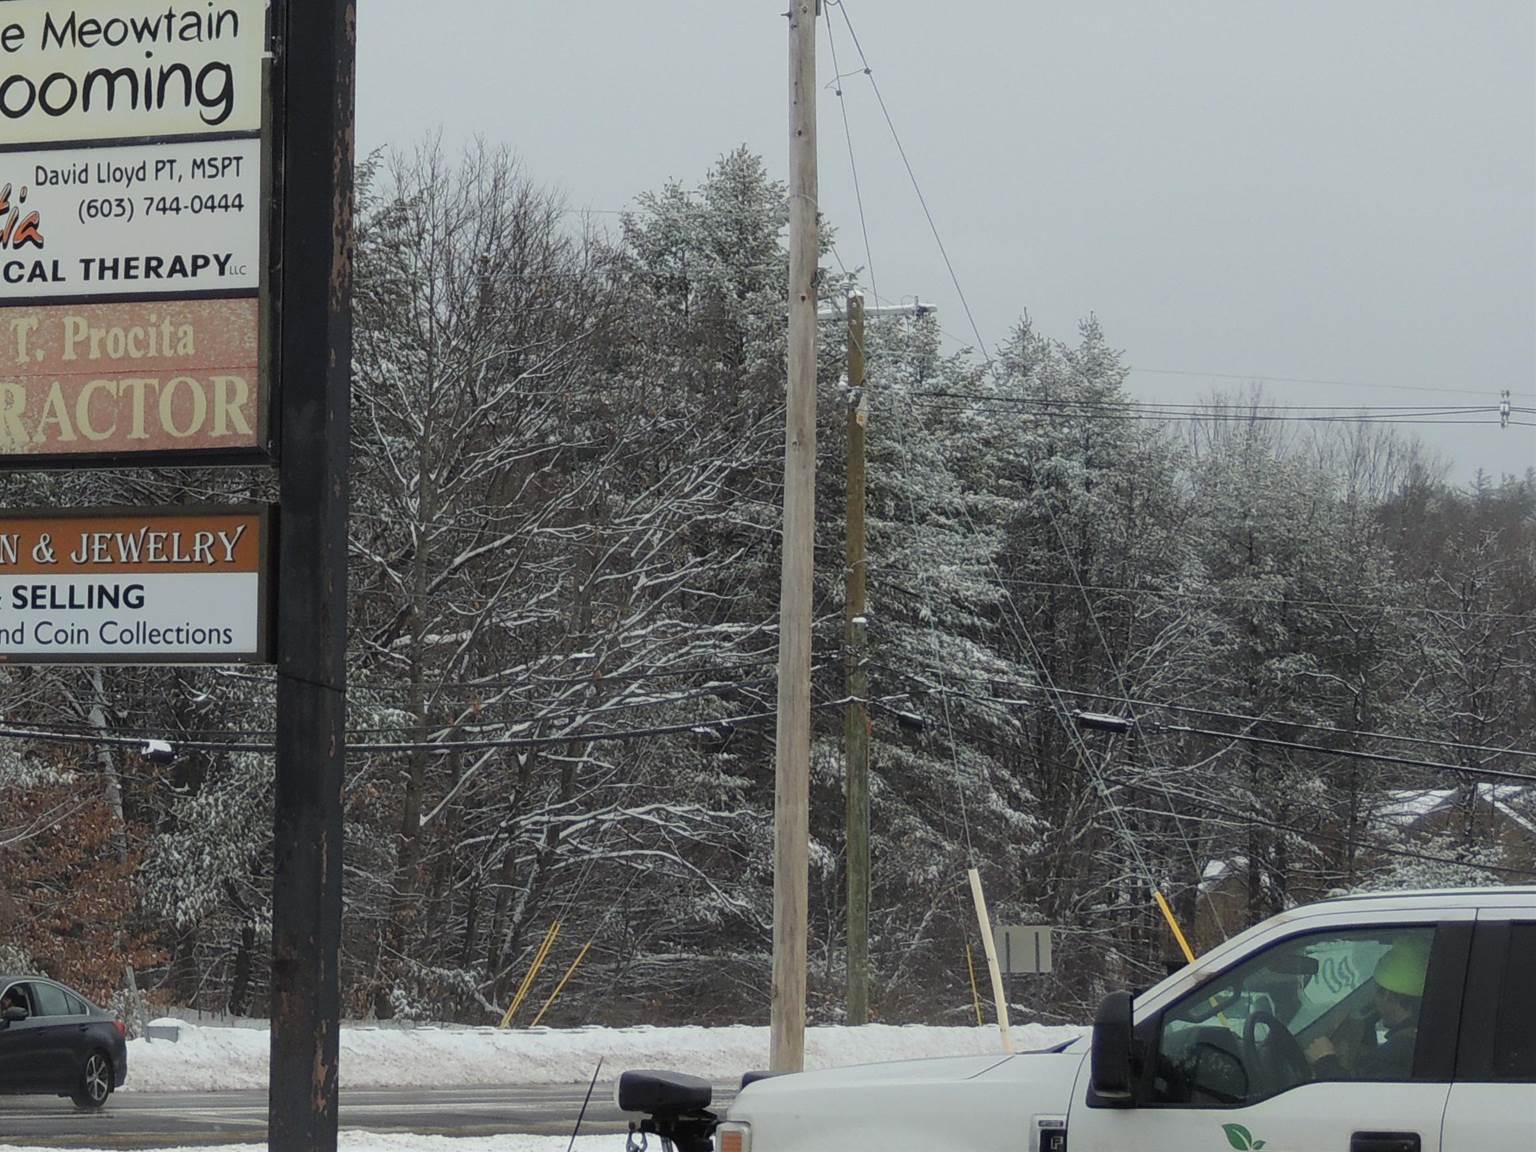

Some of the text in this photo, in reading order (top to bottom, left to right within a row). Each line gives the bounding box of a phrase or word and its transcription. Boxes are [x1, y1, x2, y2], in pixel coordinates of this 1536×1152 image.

[41, 1, 239, 51] Meowtain
[35, 156, 243, 187] David Lloyd PT, MSPT
[78, 193, 244, 223] (603) 744-0444
[80, 253, 233, 281] THERAPY
[229, 265, 247, 276] LLC
[10, 317, 44, 366] T.
[63, 315, 195, 361] Procita
[32, 536, 55, 564] &
[70, 524, 246, 566] JEWELRY
[12, 584, 145, 609] SELLING
[34, 621, 89, 645] Coin
[99, 620, 232, 646] Collections
